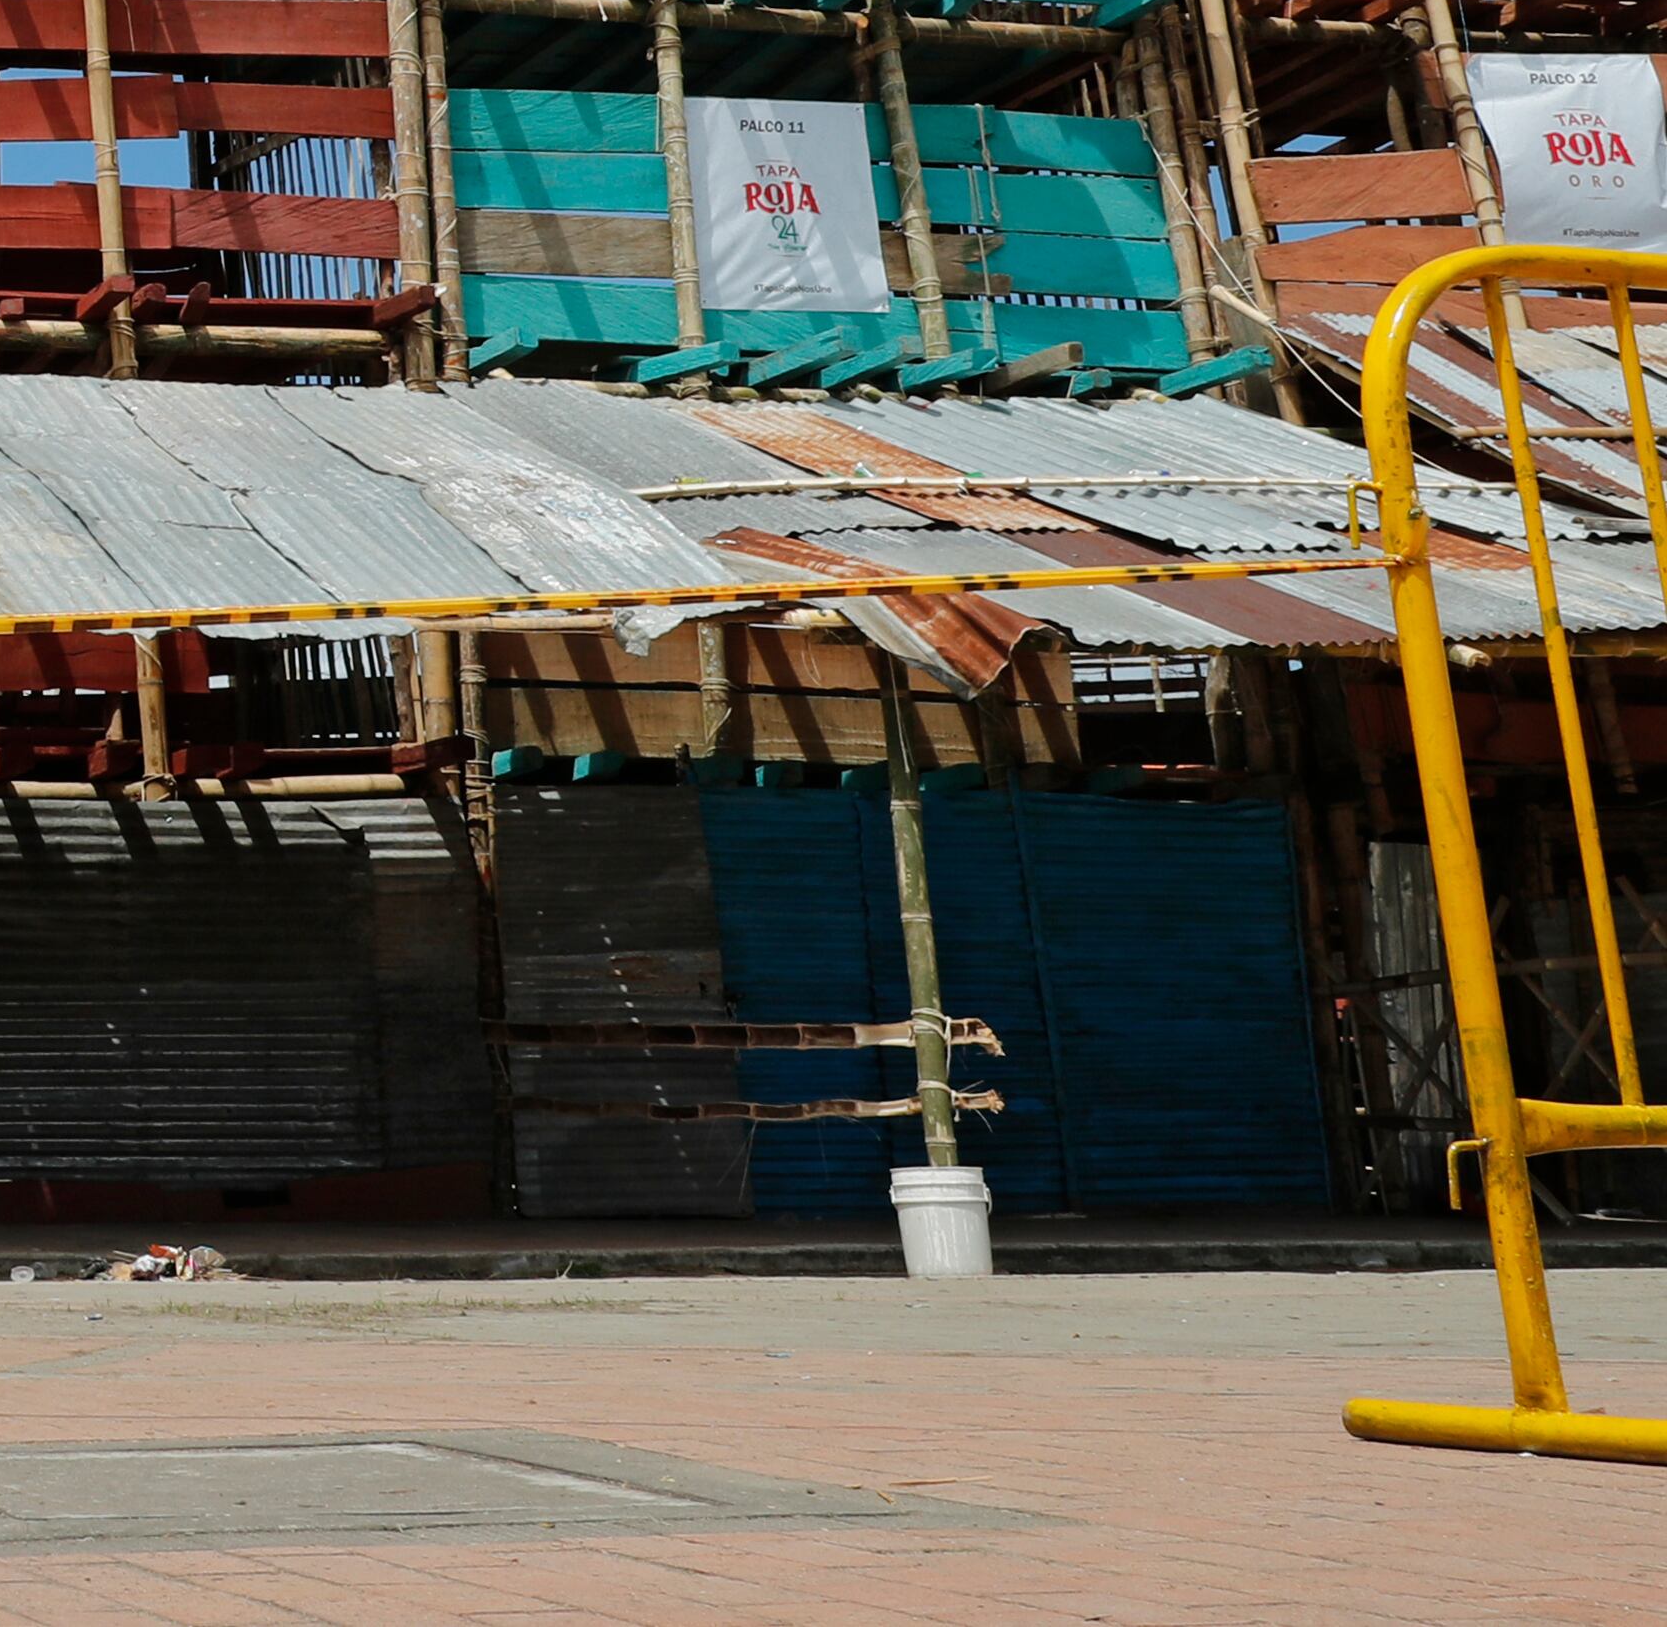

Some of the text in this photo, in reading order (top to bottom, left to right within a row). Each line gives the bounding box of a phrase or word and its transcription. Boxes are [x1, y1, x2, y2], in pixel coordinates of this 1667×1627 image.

[1530, 73, 1597, 85] PALCO 12
[740, 120, 805, 134] PALCO 11
[1553, 113, 1607, 128] TAPA
[1542, 129, 1636, 167] ROJA
[755, 164, 800, 179] TAPA
[1569, 174, 1625, 188] ORO
[742, 181, 821, 215] ROJA
[771, 215, 800, 243] 24
[1563, 228, 1640, 238] #TapaRojaNosUne
[754, 284, 832, 294] #TapaRojaNosUne
